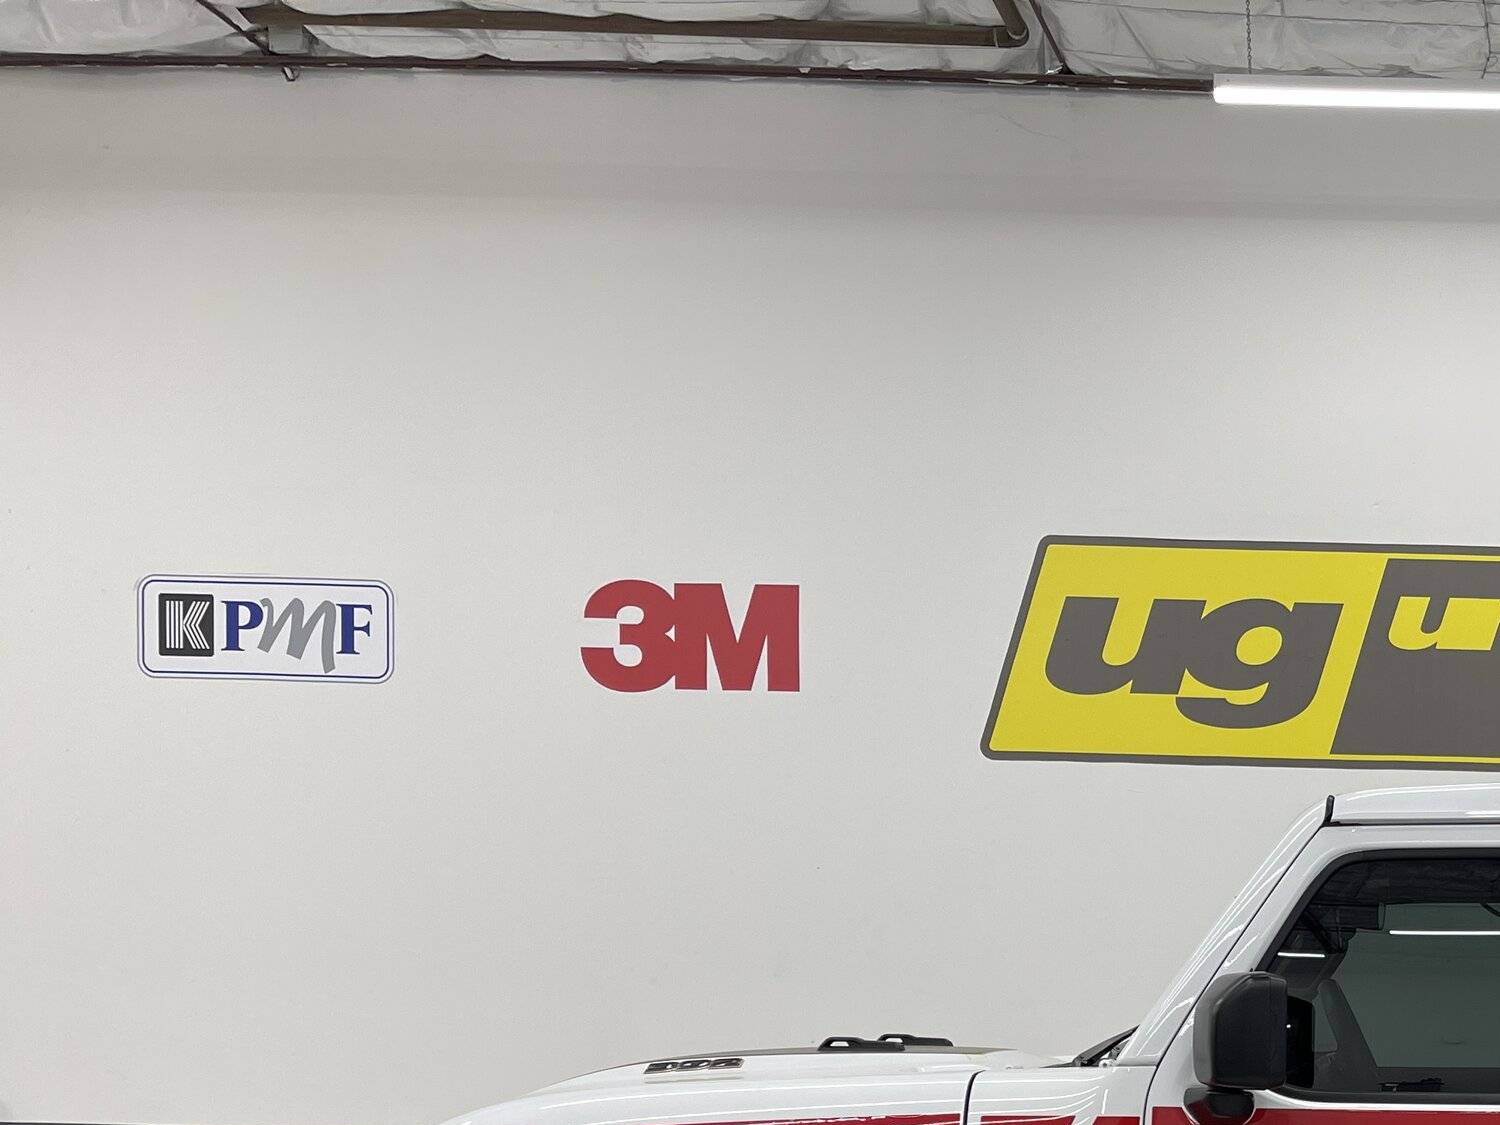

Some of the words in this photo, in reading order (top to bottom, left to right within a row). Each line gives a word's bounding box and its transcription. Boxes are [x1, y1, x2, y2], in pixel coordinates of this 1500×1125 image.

[166, 598, 373, 673] KPMF
[580, 579, 800, 692] 3M
[1045, 596, 1344, 729] ug
